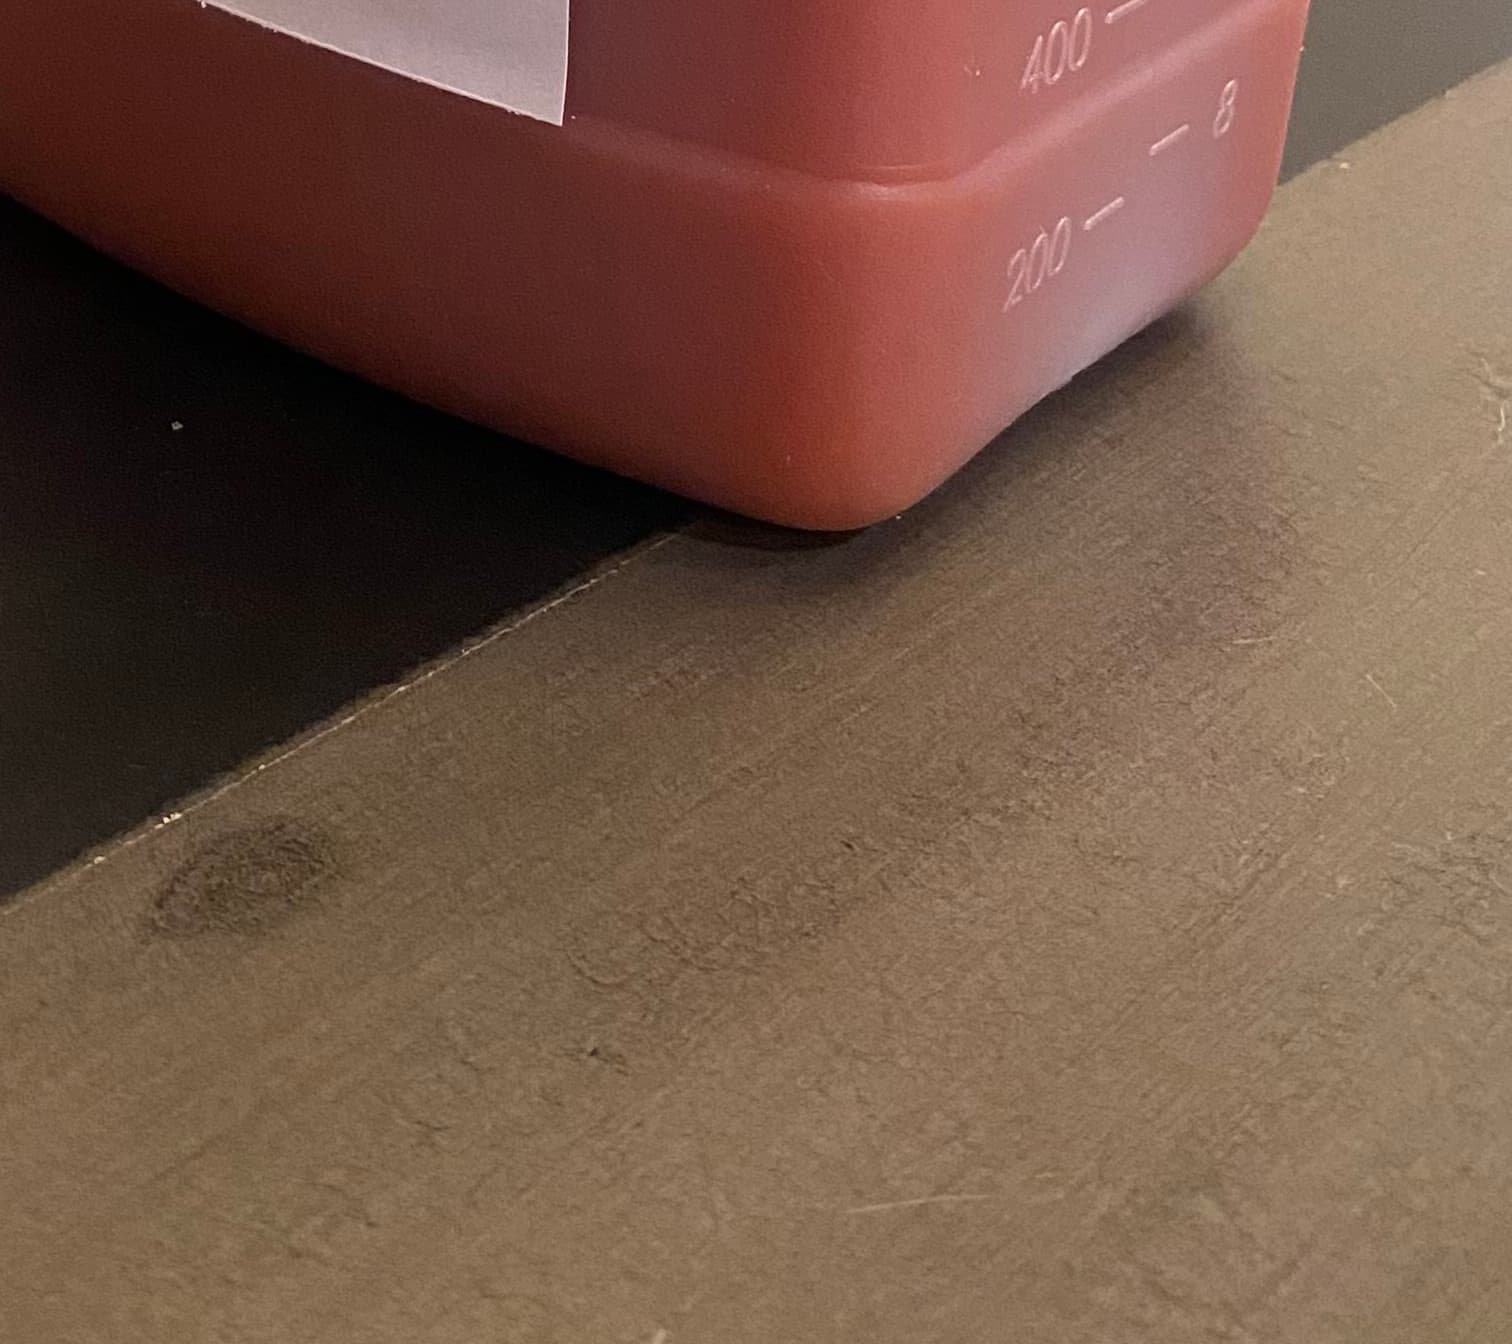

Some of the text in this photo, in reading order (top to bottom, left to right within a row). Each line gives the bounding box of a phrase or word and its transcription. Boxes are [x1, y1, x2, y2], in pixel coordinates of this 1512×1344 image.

[1019, 7, 1093, 95] 400
[1211, 78, 1238, 139] 8
[1002, 215, 1072, 314] 200
